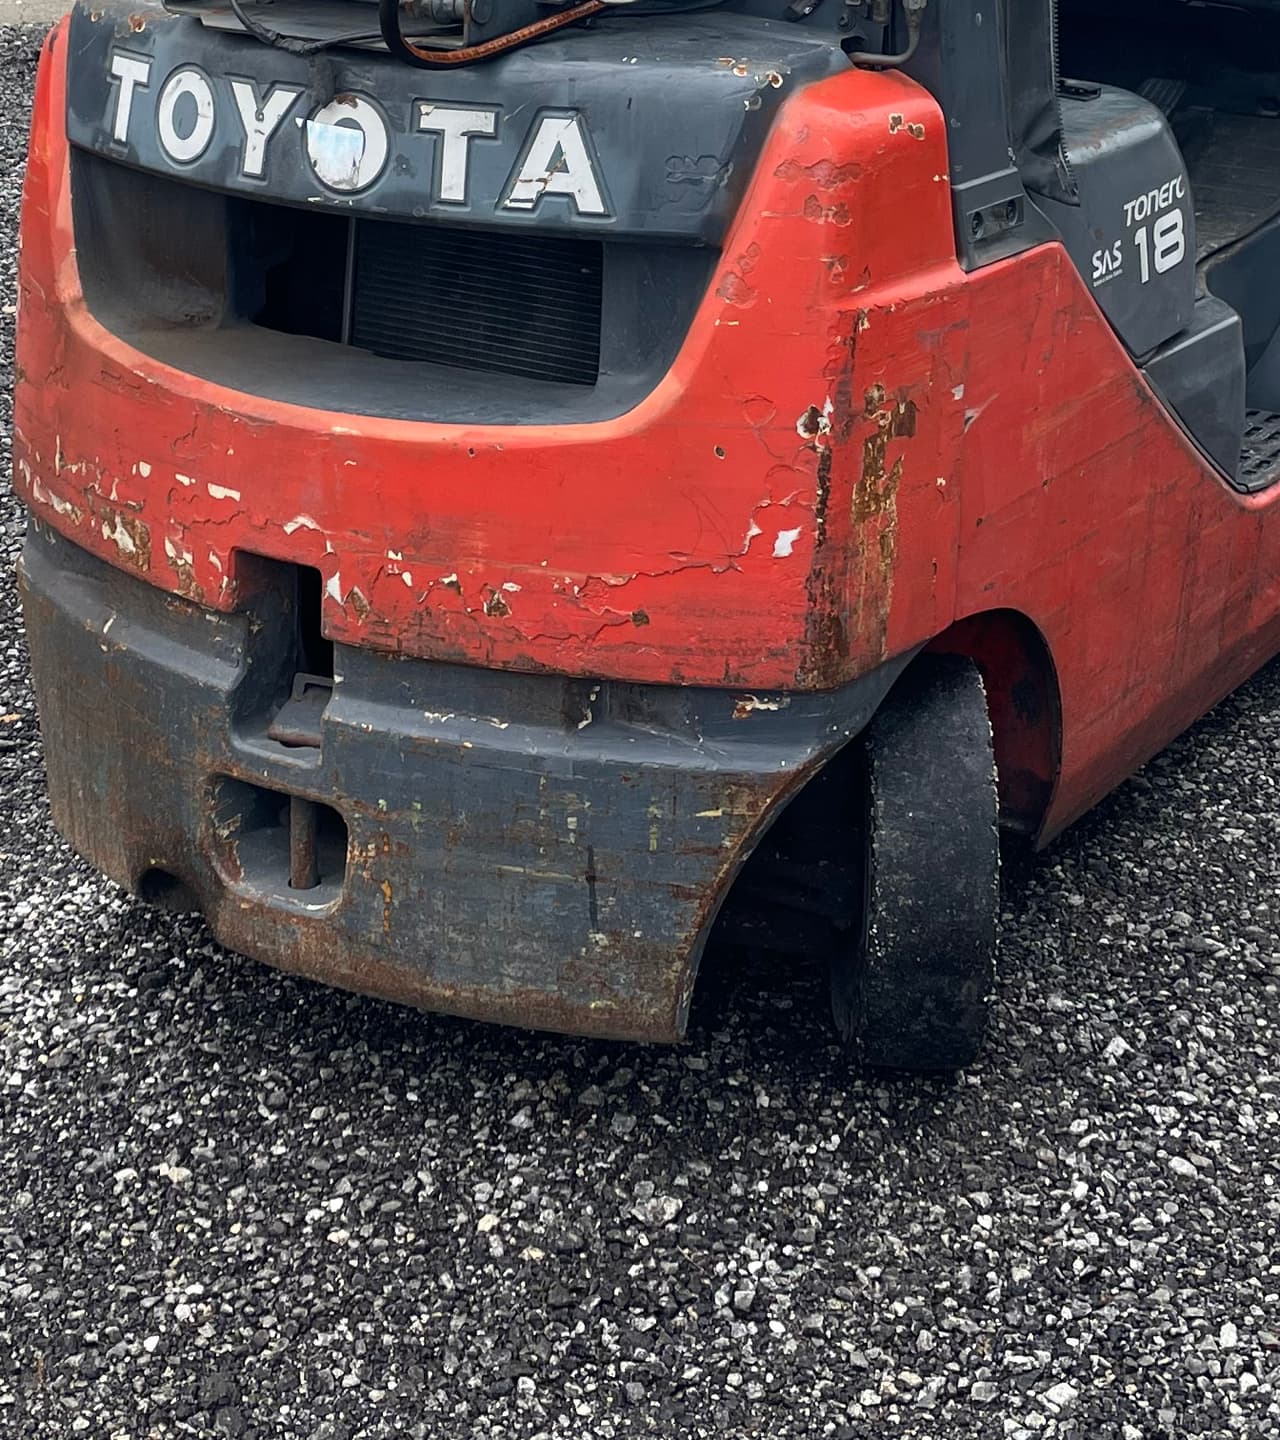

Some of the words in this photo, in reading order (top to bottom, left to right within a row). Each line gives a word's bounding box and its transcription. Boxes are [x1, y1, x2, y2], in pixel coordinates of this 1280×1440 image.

[111, 55, 607, 214] TOYOTA
[1092, 239, 1122, 279] SAS
[1134, 208, 1185, 284] 18
